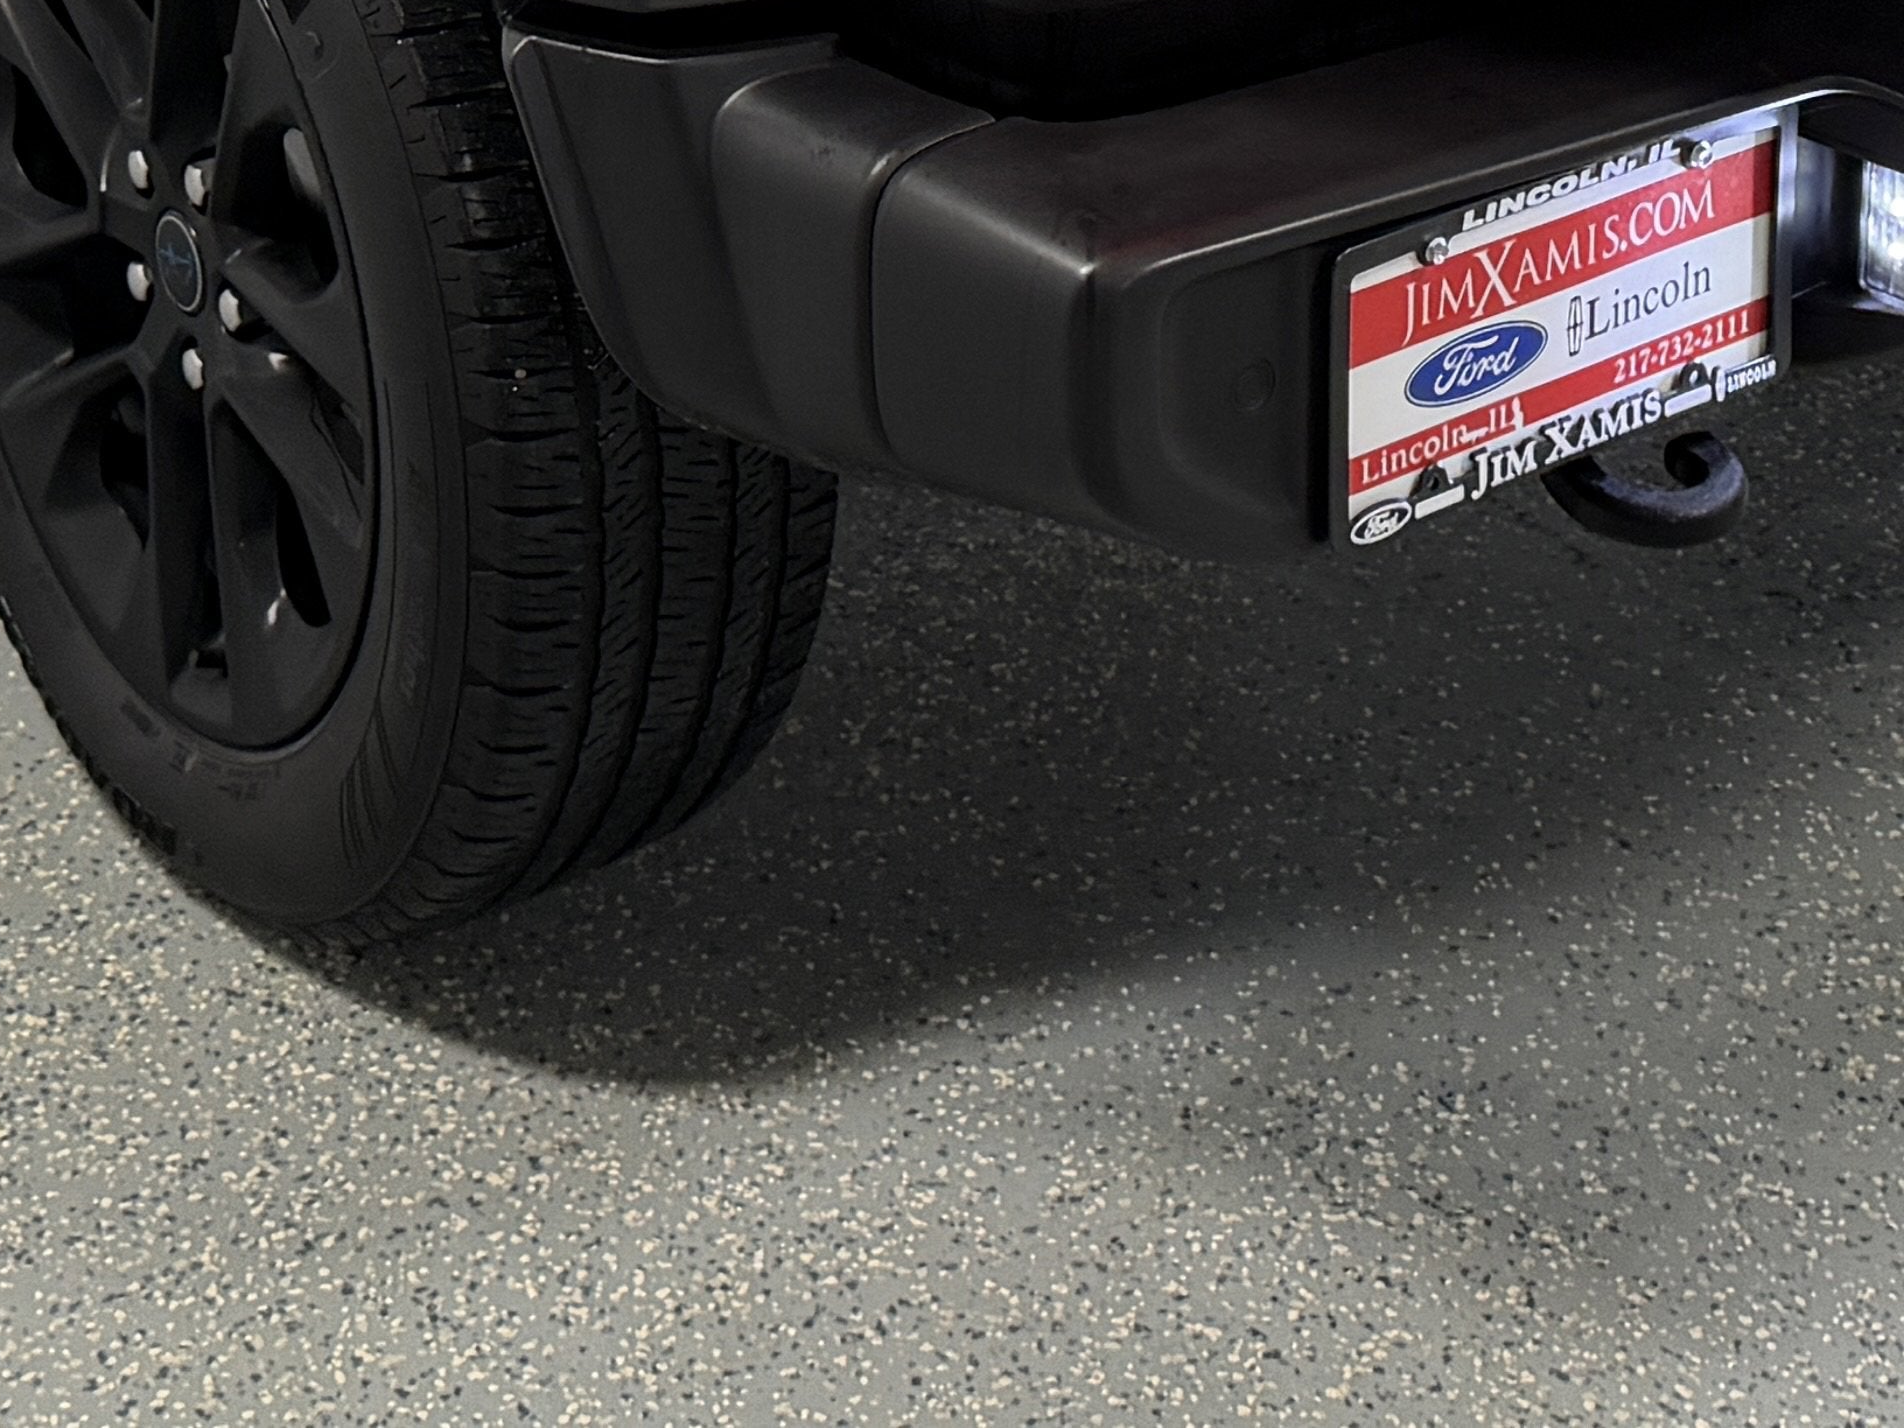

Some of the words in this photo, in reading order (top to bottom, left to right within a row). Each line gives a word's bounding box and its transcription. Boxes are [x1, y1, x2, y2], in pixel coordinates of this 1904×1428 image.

[1648, 138, 1682, 163] IL
[1585, 261, 1712, 341] Lincoln
[1433, 331, 1518, 397] Ford
[1613, 309, 1750, 384] 217-732-2111
[1727, 359, 1777, 393] LINCOLN
[1471, 440, 1538, 501] JIM
[1544, 389, 1662, 465] XAMIS
